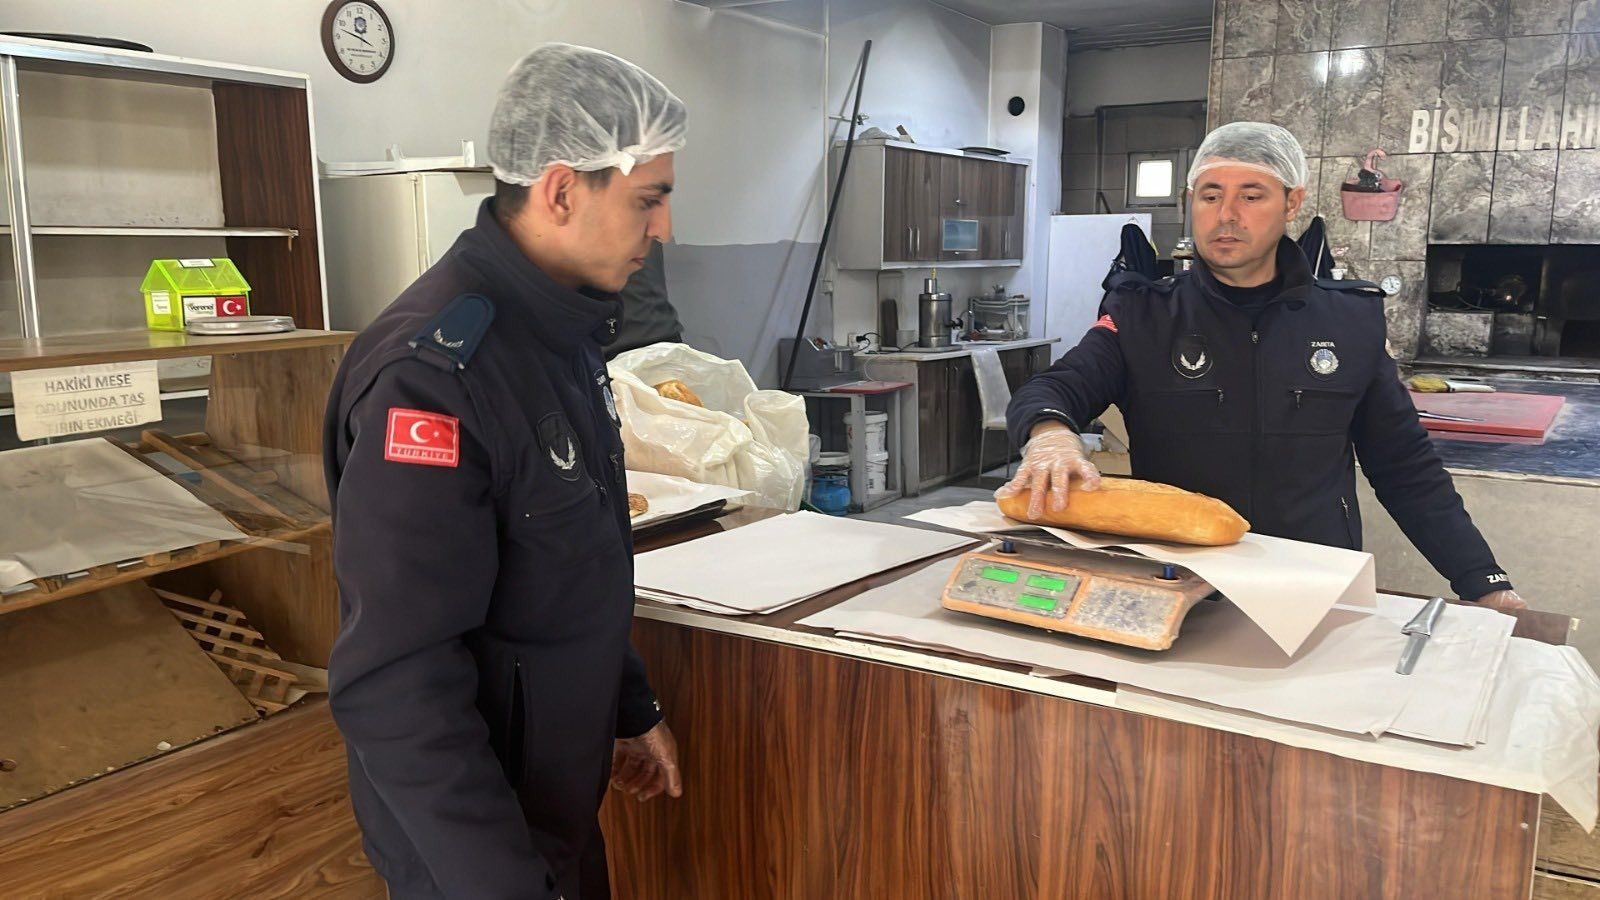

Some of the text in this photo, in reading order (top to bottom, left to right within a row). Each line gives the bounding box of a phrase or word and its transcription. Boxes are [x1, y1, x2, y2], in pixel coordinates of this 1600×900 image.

[1408, 93, 1600, 153] BİSMİLLAHİ
[45, 373, 132, 393] HAKİKİ MEŞE
[119, 392, 145, 406] TAŞ
[86, 410, 138, 430] EKMEĞİ
